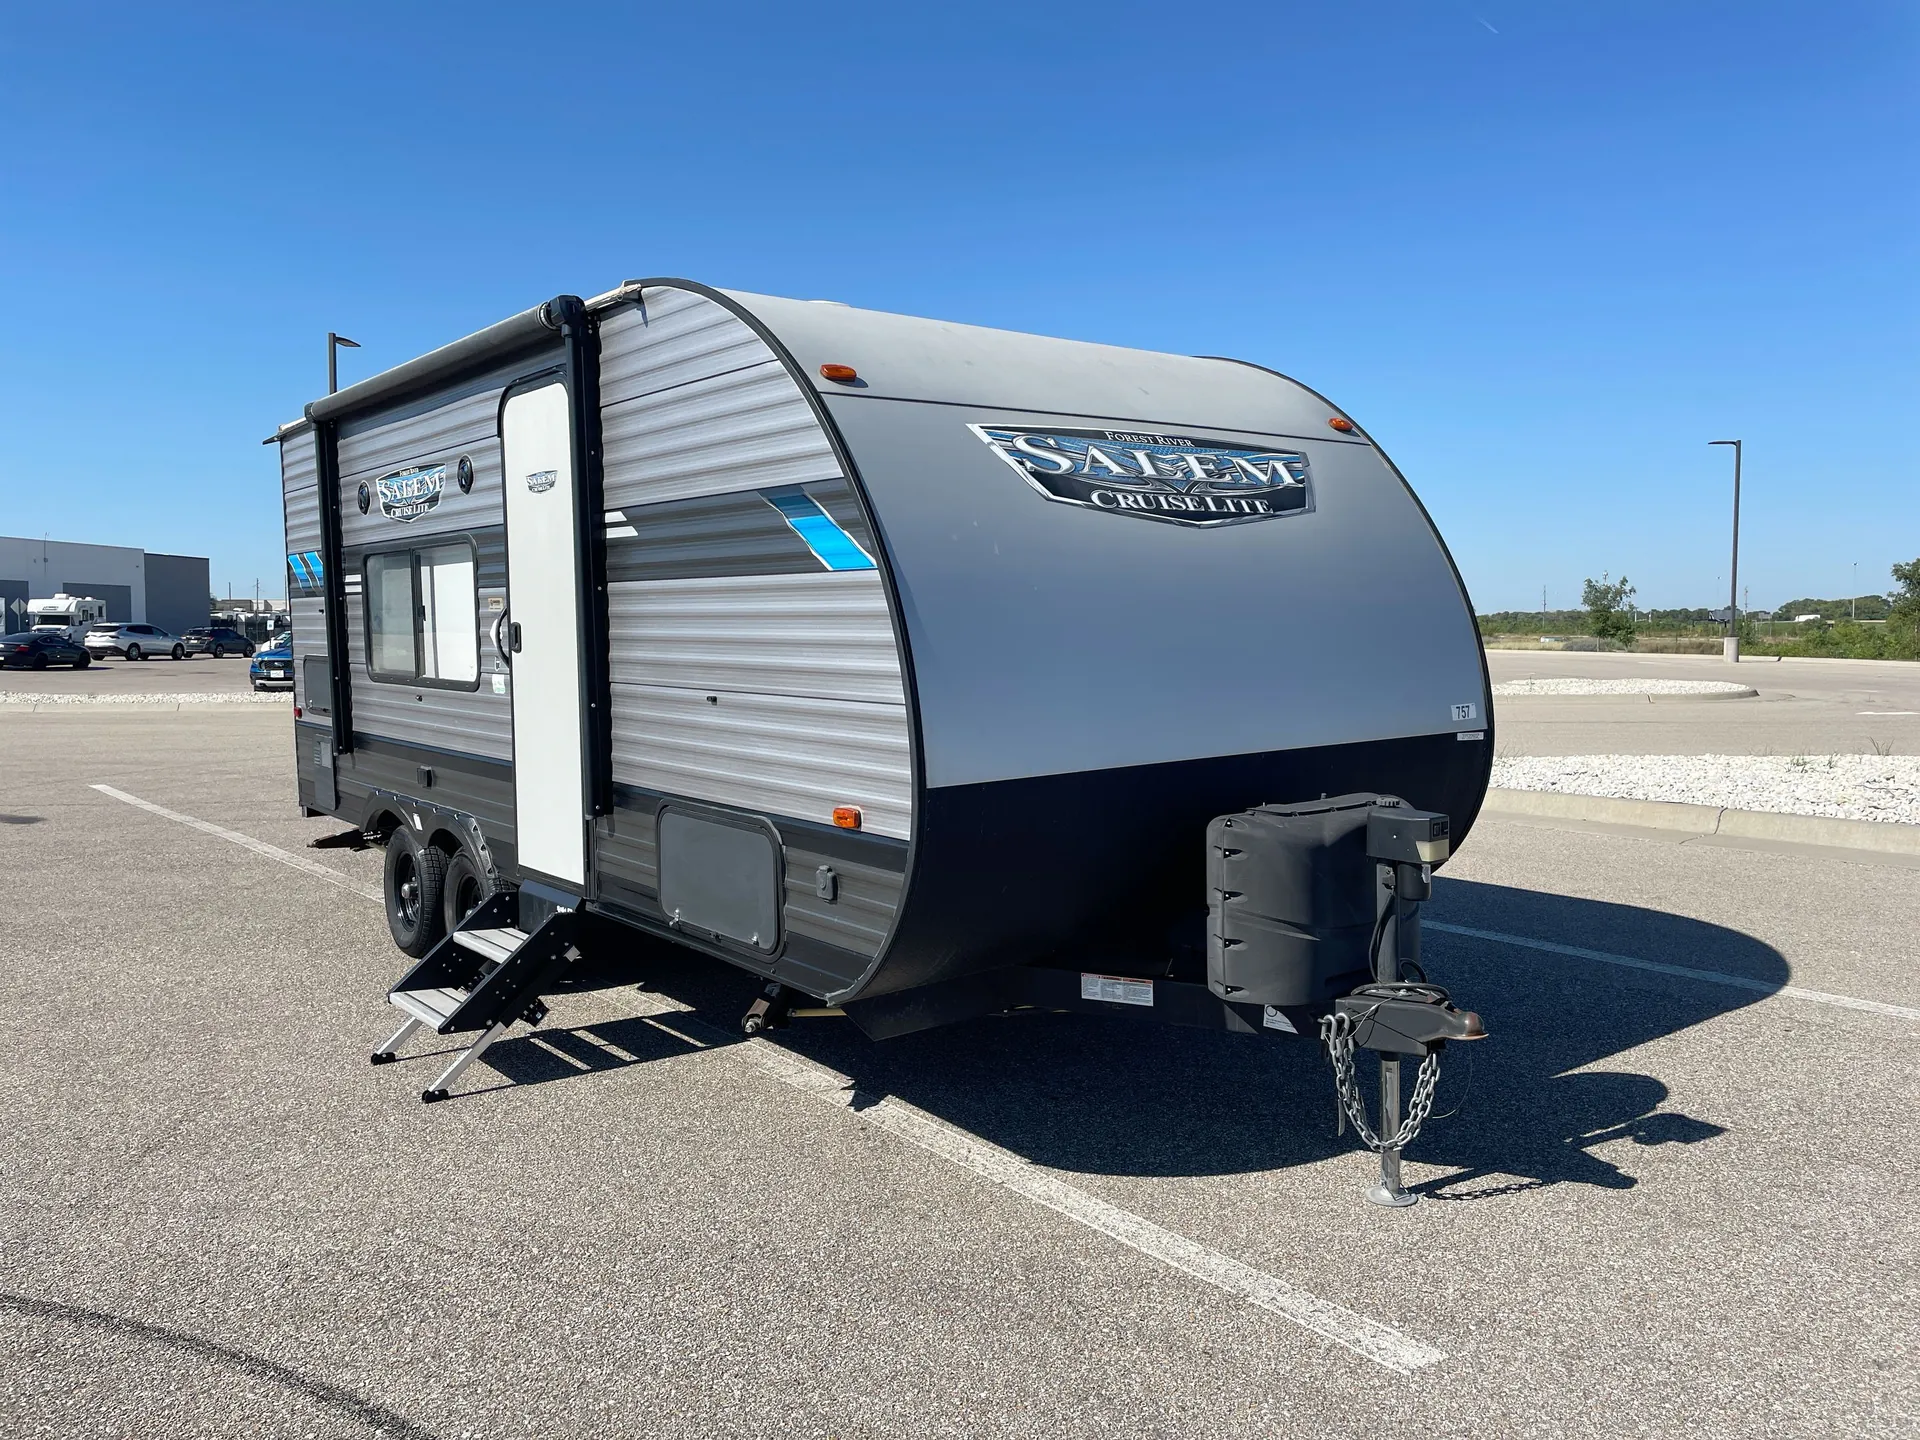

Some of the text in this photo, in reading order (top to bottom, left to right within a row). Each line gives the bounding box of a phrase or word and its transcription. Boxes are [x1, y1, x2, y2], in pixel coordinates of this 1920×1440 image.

[1105, 431, 1196, 448] FOREST RIVER
[1012, 433, 1305, 488] SALEM
[381, 472, 445, 502] SALEM
[390, 502, 430, 518] CRUISE LITE
[1455, 705, 1470, 719] 757
